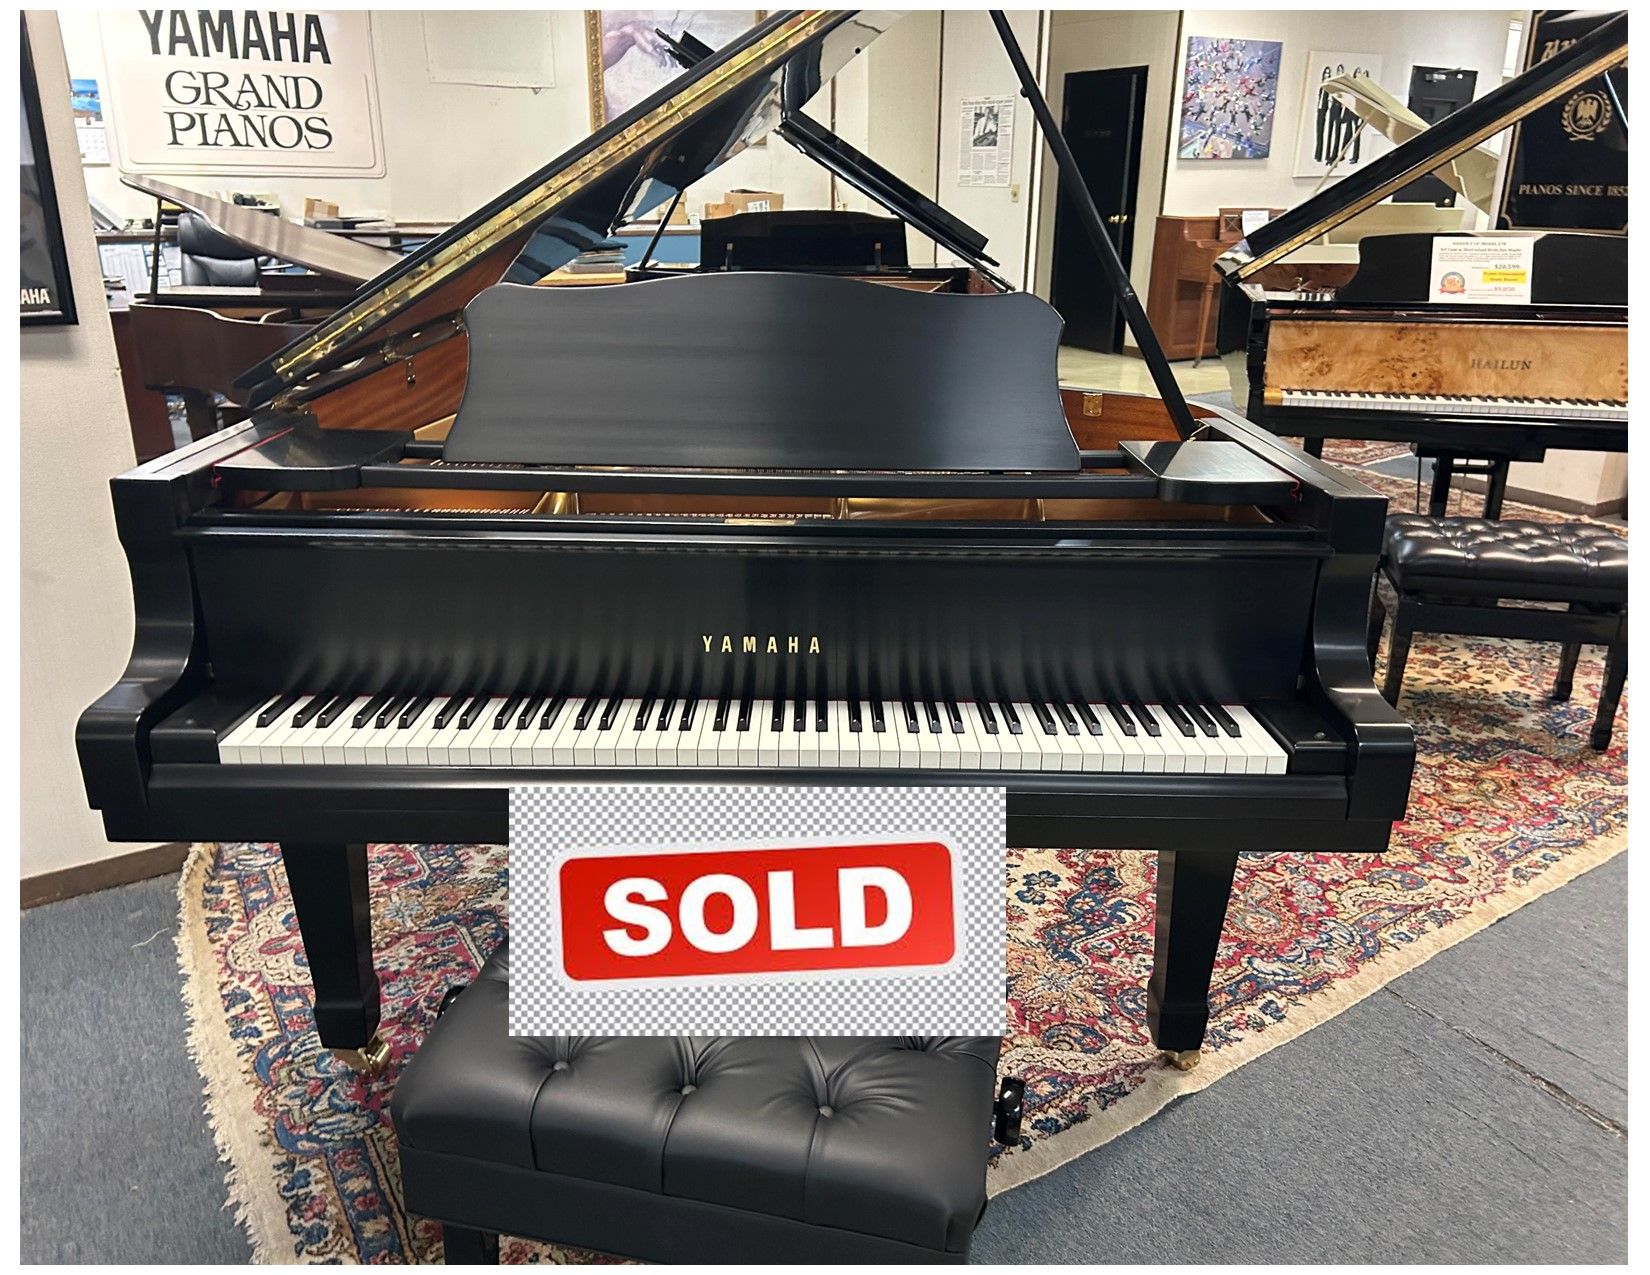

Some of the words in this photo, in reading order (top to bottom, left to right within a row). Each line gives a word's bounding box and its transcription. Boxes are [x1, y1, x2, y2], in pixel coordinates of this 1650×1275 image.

[138, 10, 332, 65] YAMAHA
[165, 70, 323, 111] GRAND
[164, 111, 333, 150] PIANOS
[1518, 184, 1563, 195] PIANOS
[1565, 184, 1604, 196] SINCE
[1471, 358, 1532, 371] HAILUN
[702, 635, 821, 654] YAMAHA
